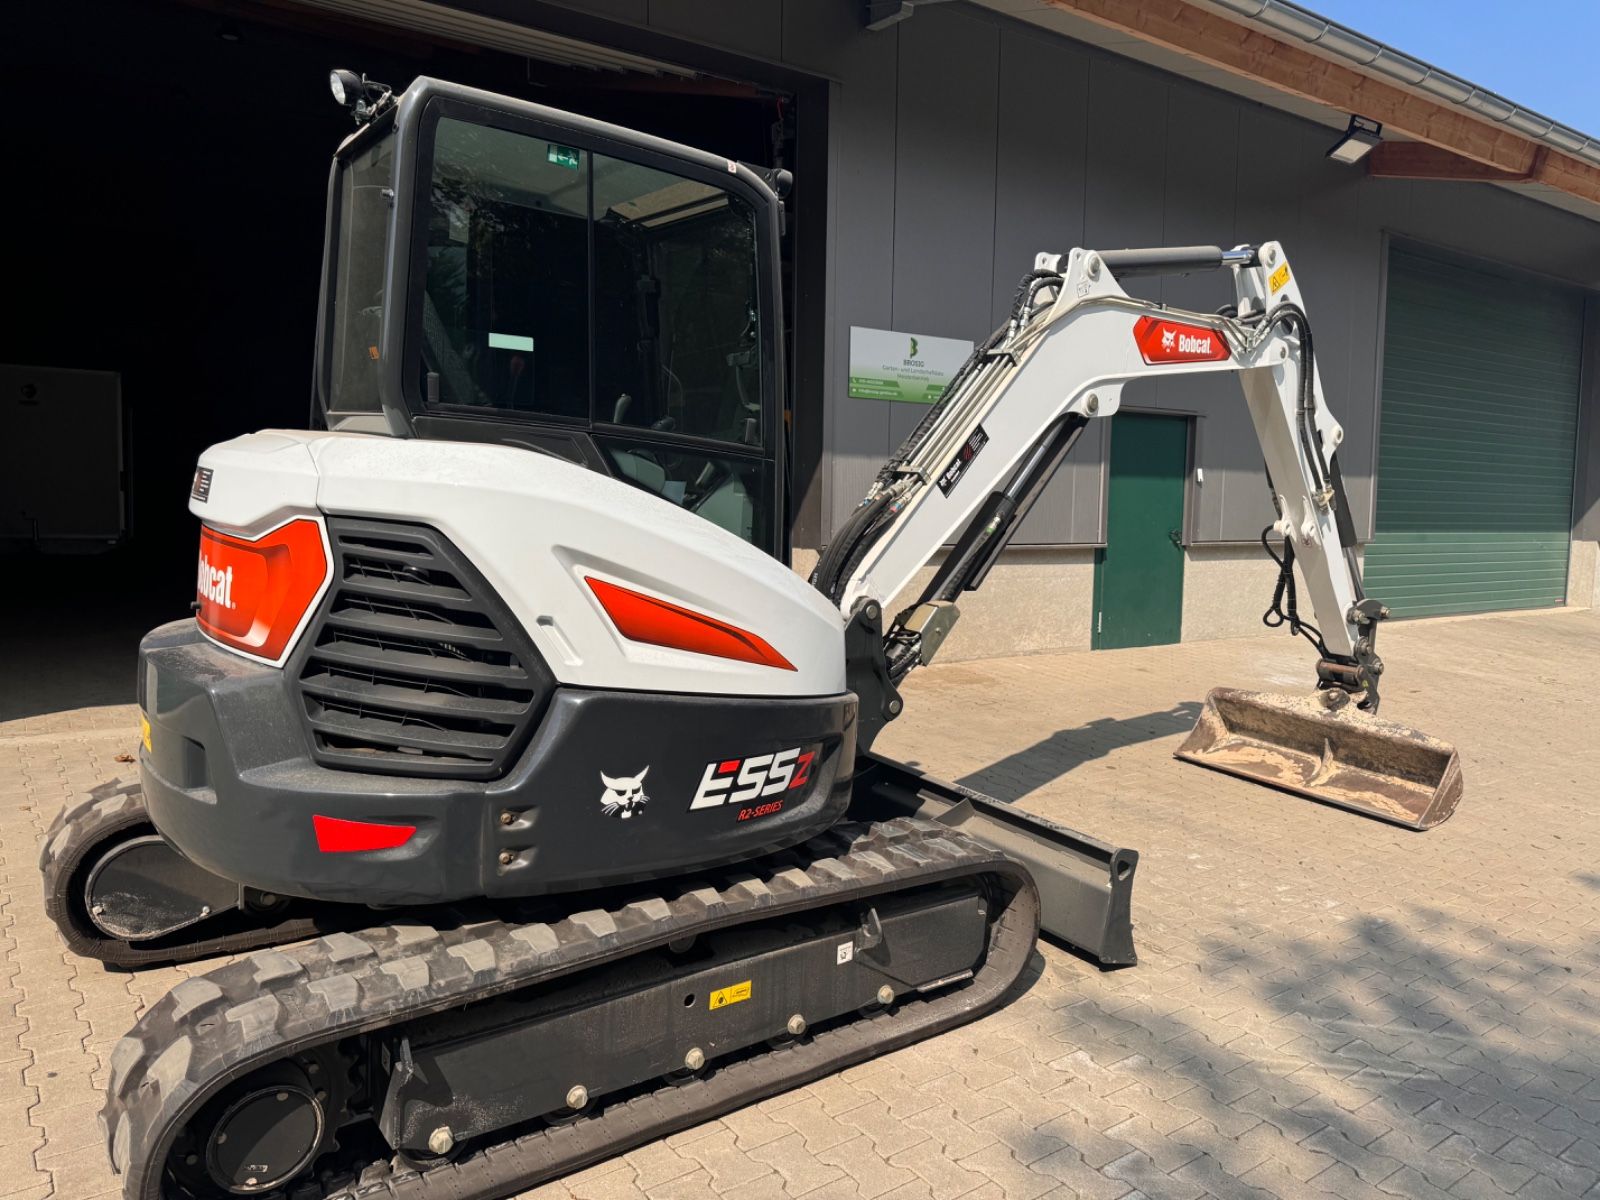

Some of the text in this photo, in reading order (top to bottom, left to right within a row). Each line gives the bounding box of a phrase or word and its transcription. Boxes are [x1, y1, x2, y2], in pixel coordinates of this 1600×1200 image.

[1178, 334, 1211, 354] Bobcat
[197, 550, 233, 609] obcat
[737, 800, 784, 821] R2-SERIES
